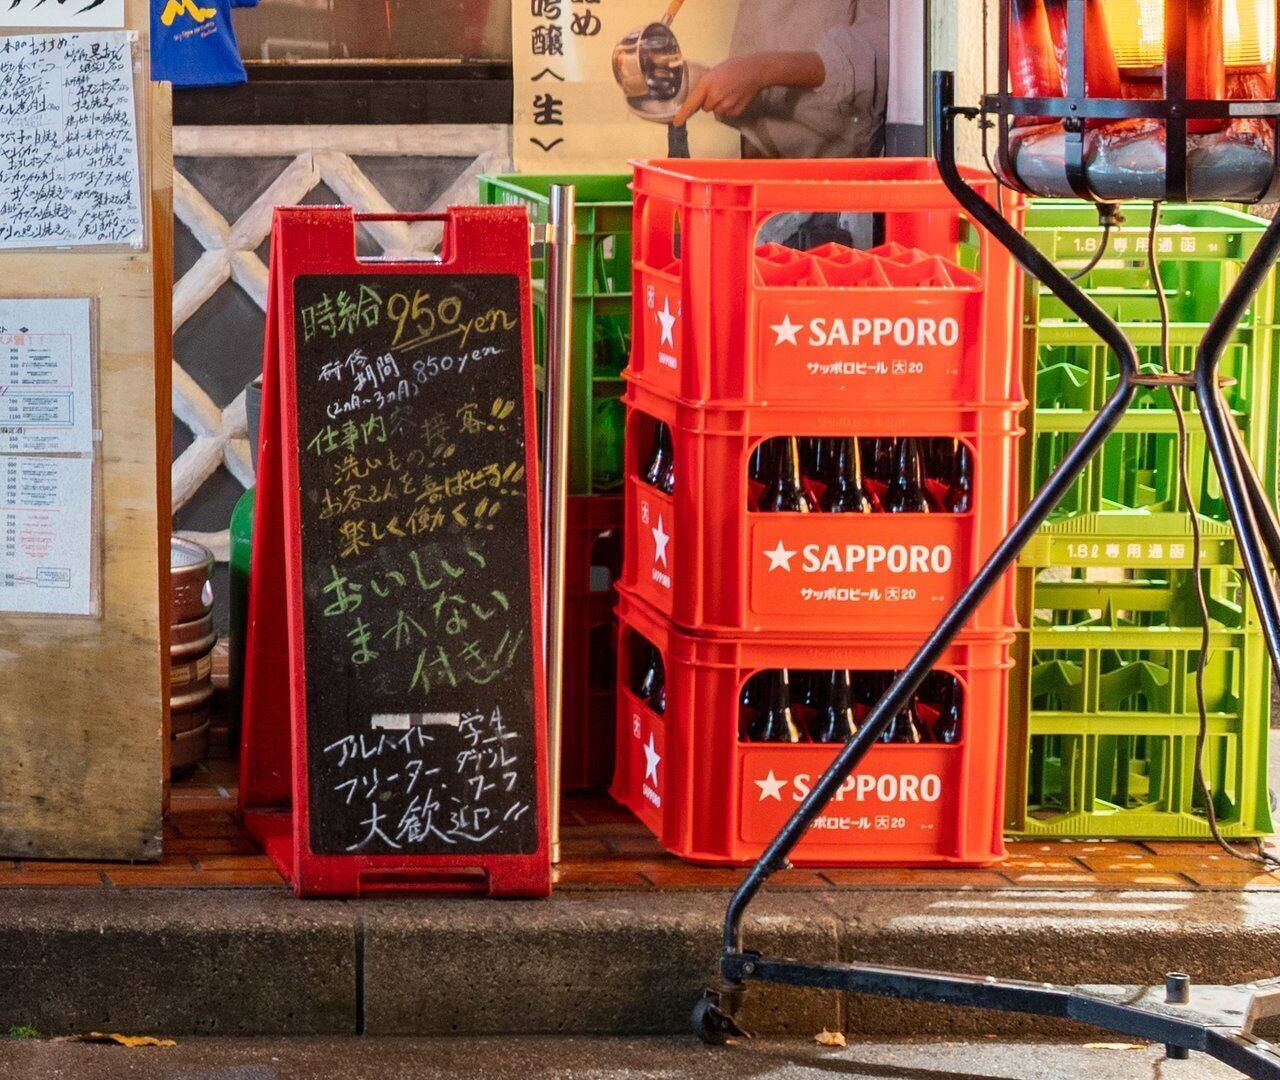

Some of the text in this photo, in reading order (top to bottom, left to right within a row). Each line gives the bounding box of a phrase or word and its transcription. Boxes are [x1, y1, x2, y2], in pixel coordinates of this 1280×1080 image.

[301, 284, 384, 343] 時給
[808, 316, 960, 348] SAPPORO
[806, 360, 889, 376] サッポロビール
[908, 360, 924, 375] 20
[801, 543, 952, 574] SAPPORO
[321, 548, 488, 618] おいしい
[800, 586, 882, 602] サッポロビール
[901, 587, 917, 601] 20
[345, 589, 510, 665] まかない
[792, 773, 942, 803] SPPORO
[891, 816, 906, 829] 20
